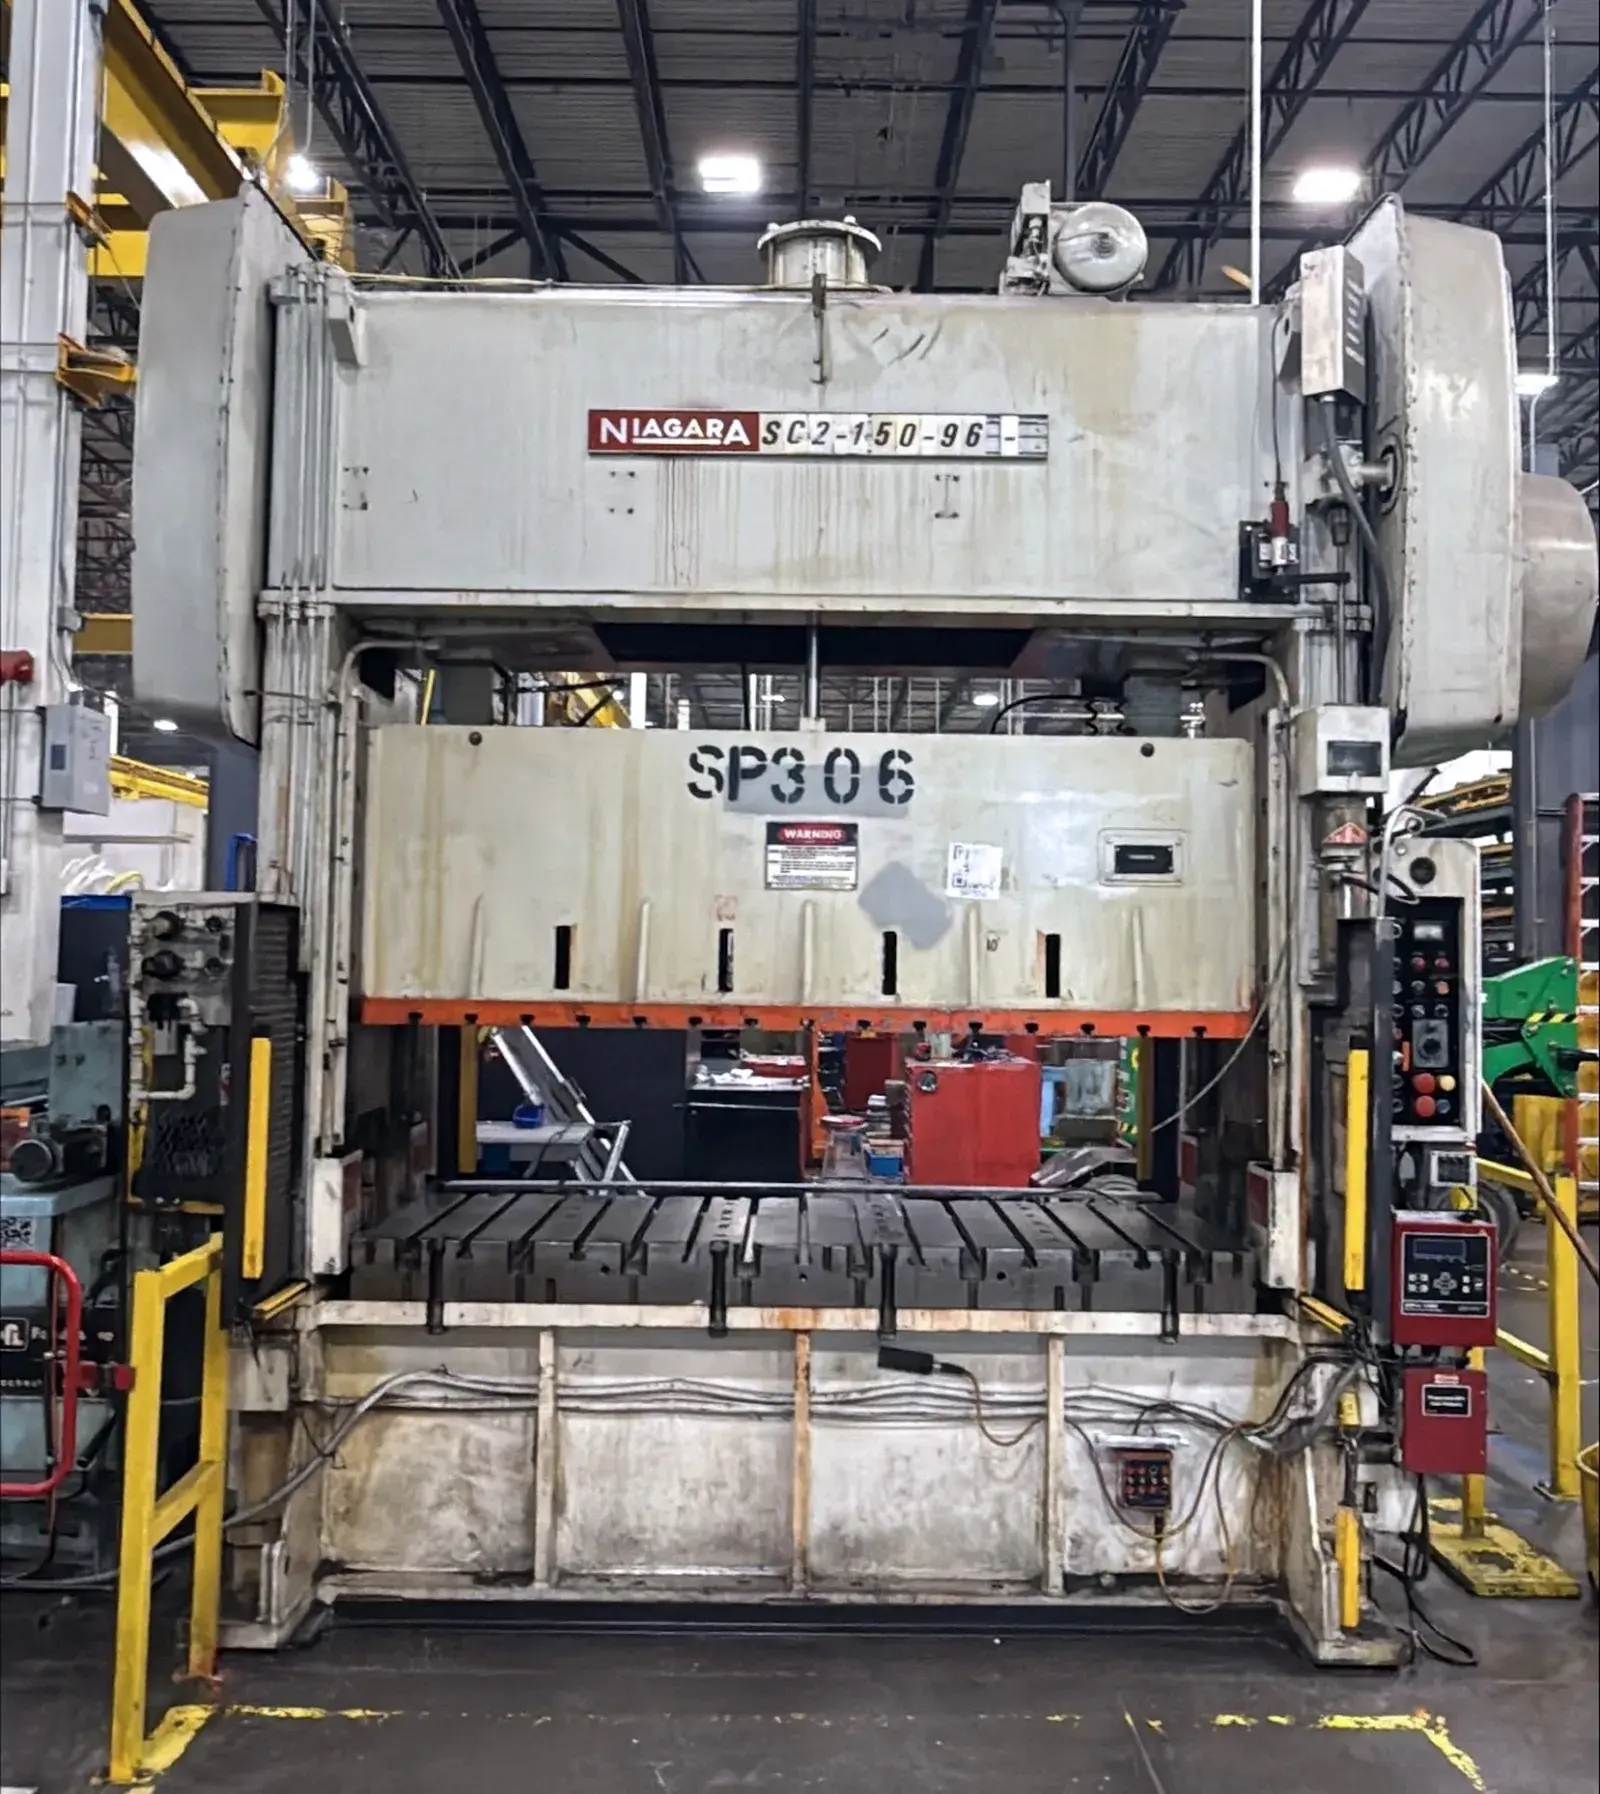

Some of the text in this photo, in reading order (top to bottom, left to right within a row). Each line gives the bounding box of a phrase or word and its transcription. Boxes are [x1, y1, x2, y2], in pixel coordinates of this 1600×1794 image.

[600, 417, 751, 446] NIAGARA
[687, 744, 915, 805] SP306
[784, 828, 842, 839] WARNING
